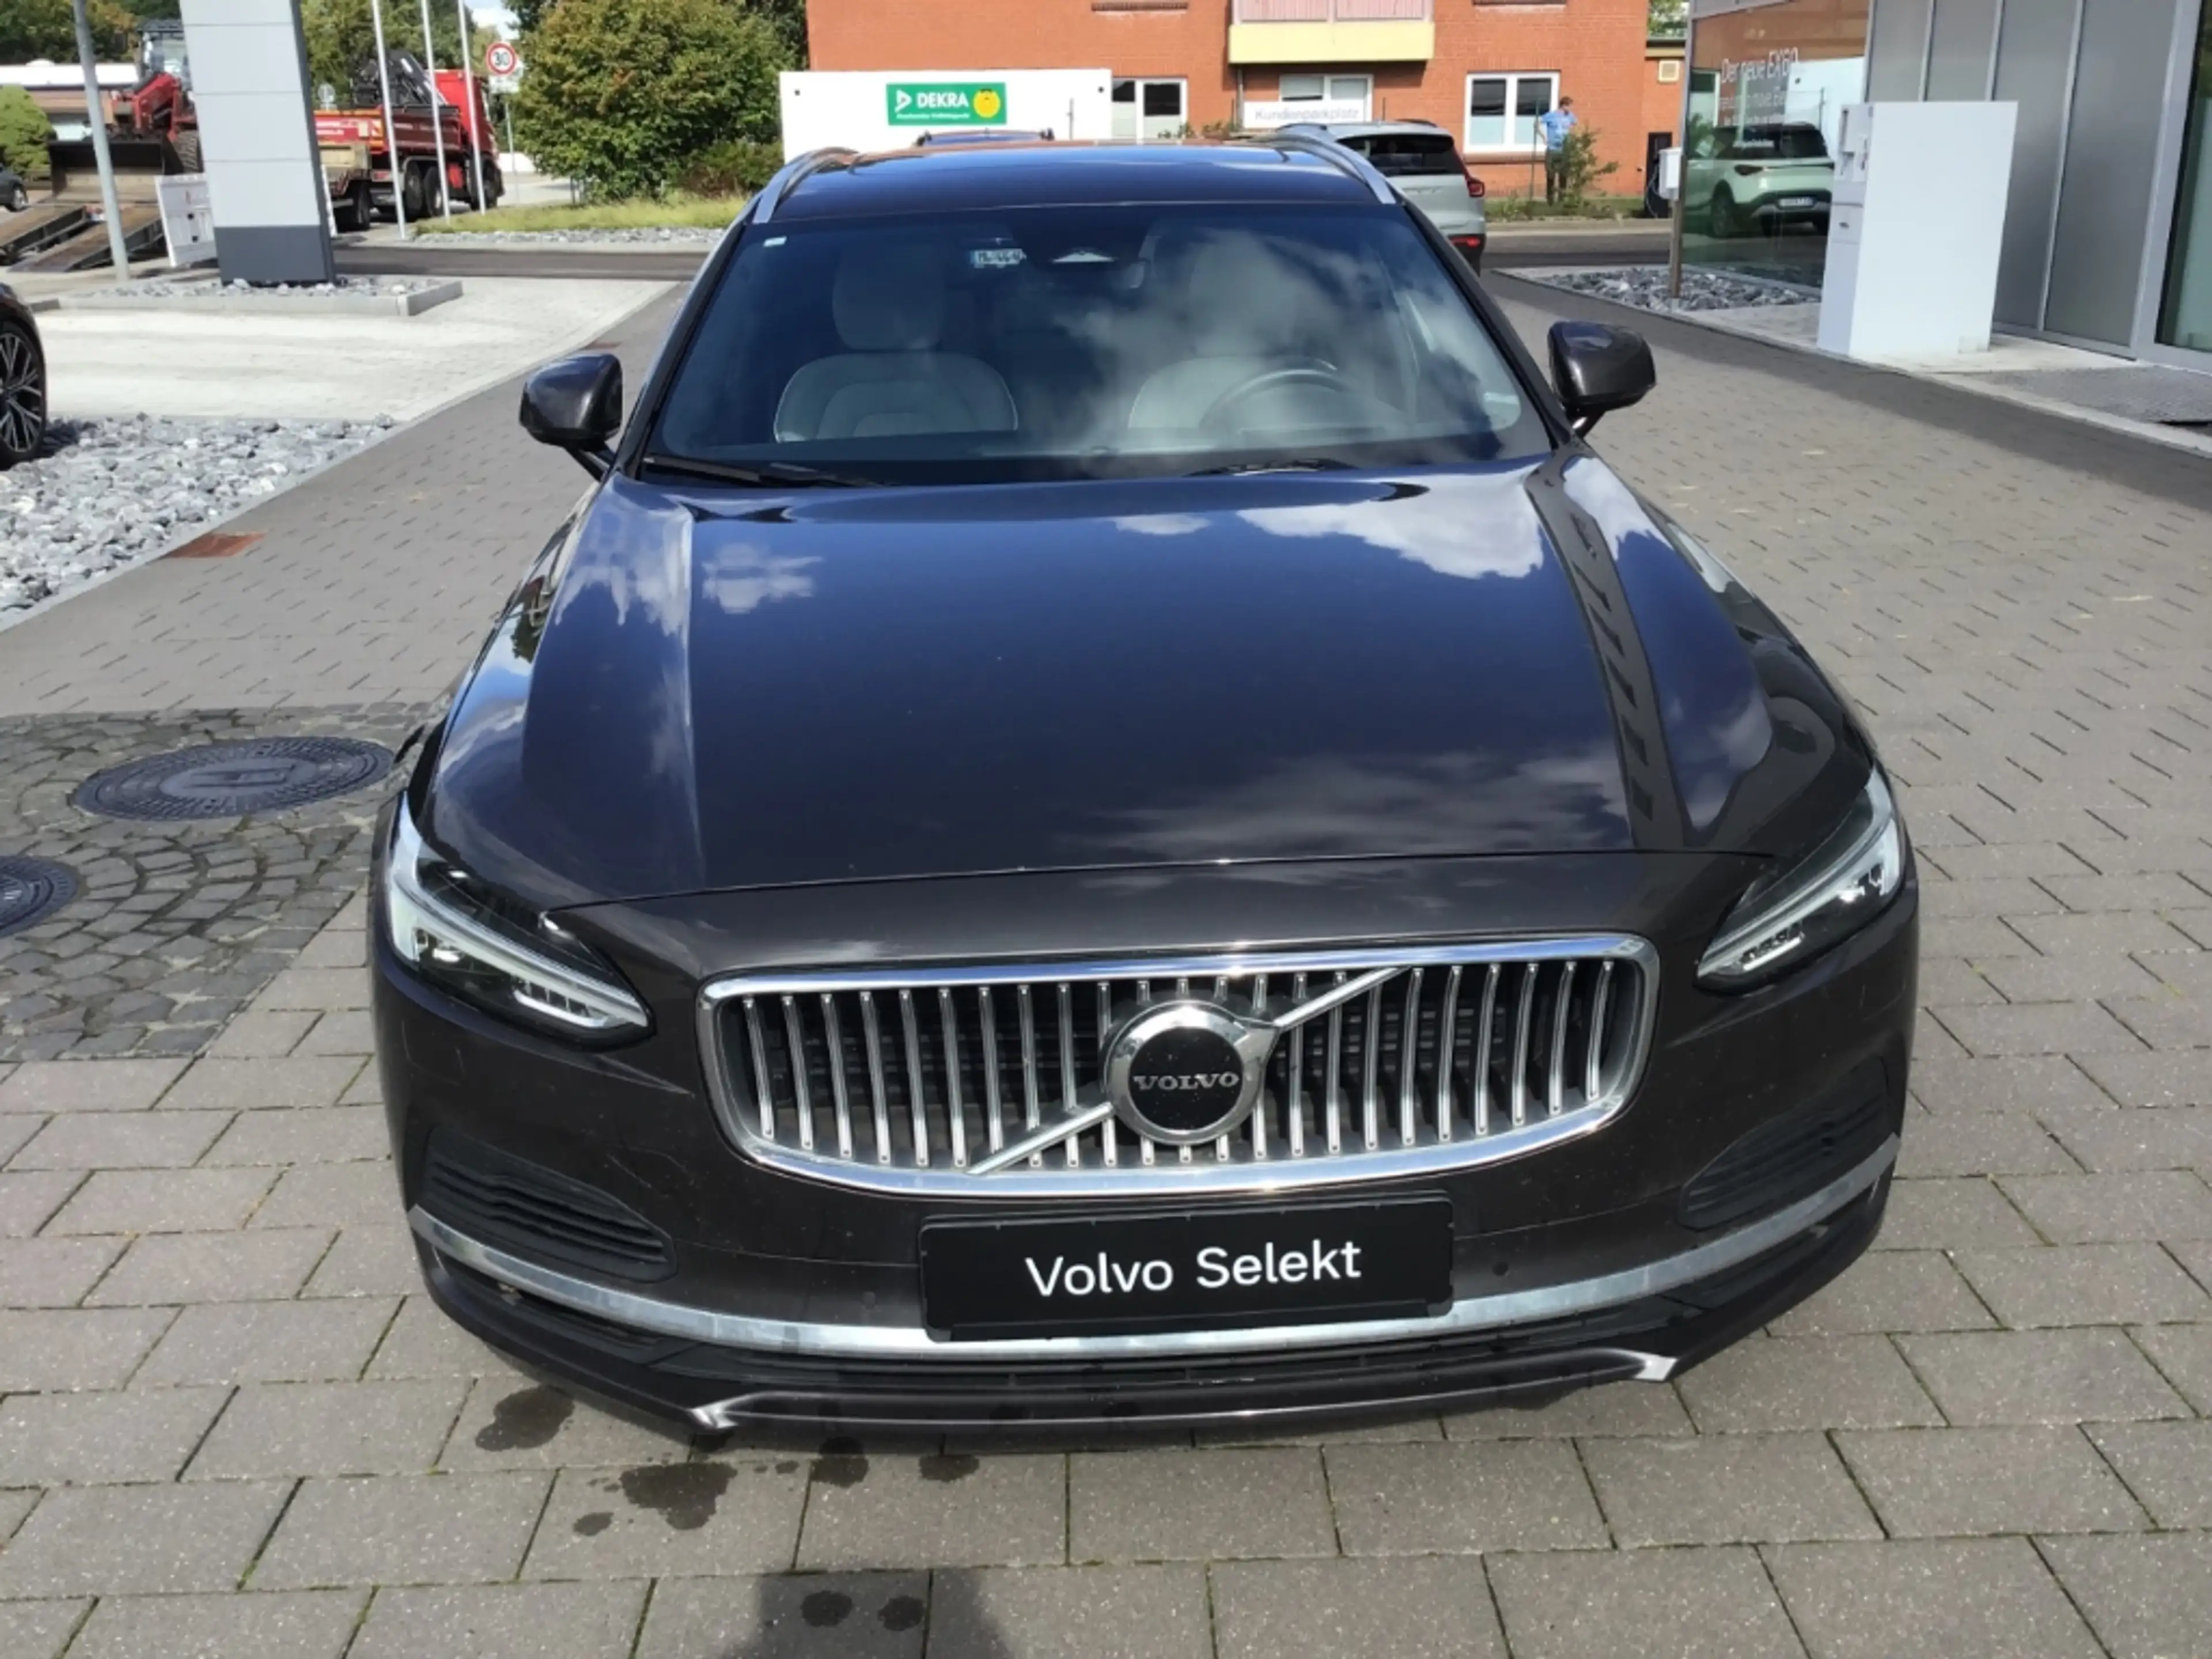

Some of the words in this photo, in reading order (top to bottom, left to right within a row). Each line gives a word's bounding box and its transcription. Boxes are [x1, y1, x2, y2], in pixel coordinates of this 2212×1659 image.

[494, 52, 509, 66] 30
[916, 92, 969, 108] DEKRA
[1255, 107, 1359, 122] Kundenparkplatz
[1132, 1071, 1239, 1090] VOLVO
[1025, 1252, 1173, 1296] Volvo
[1196, 1239, 1361, 1288] Selekt
